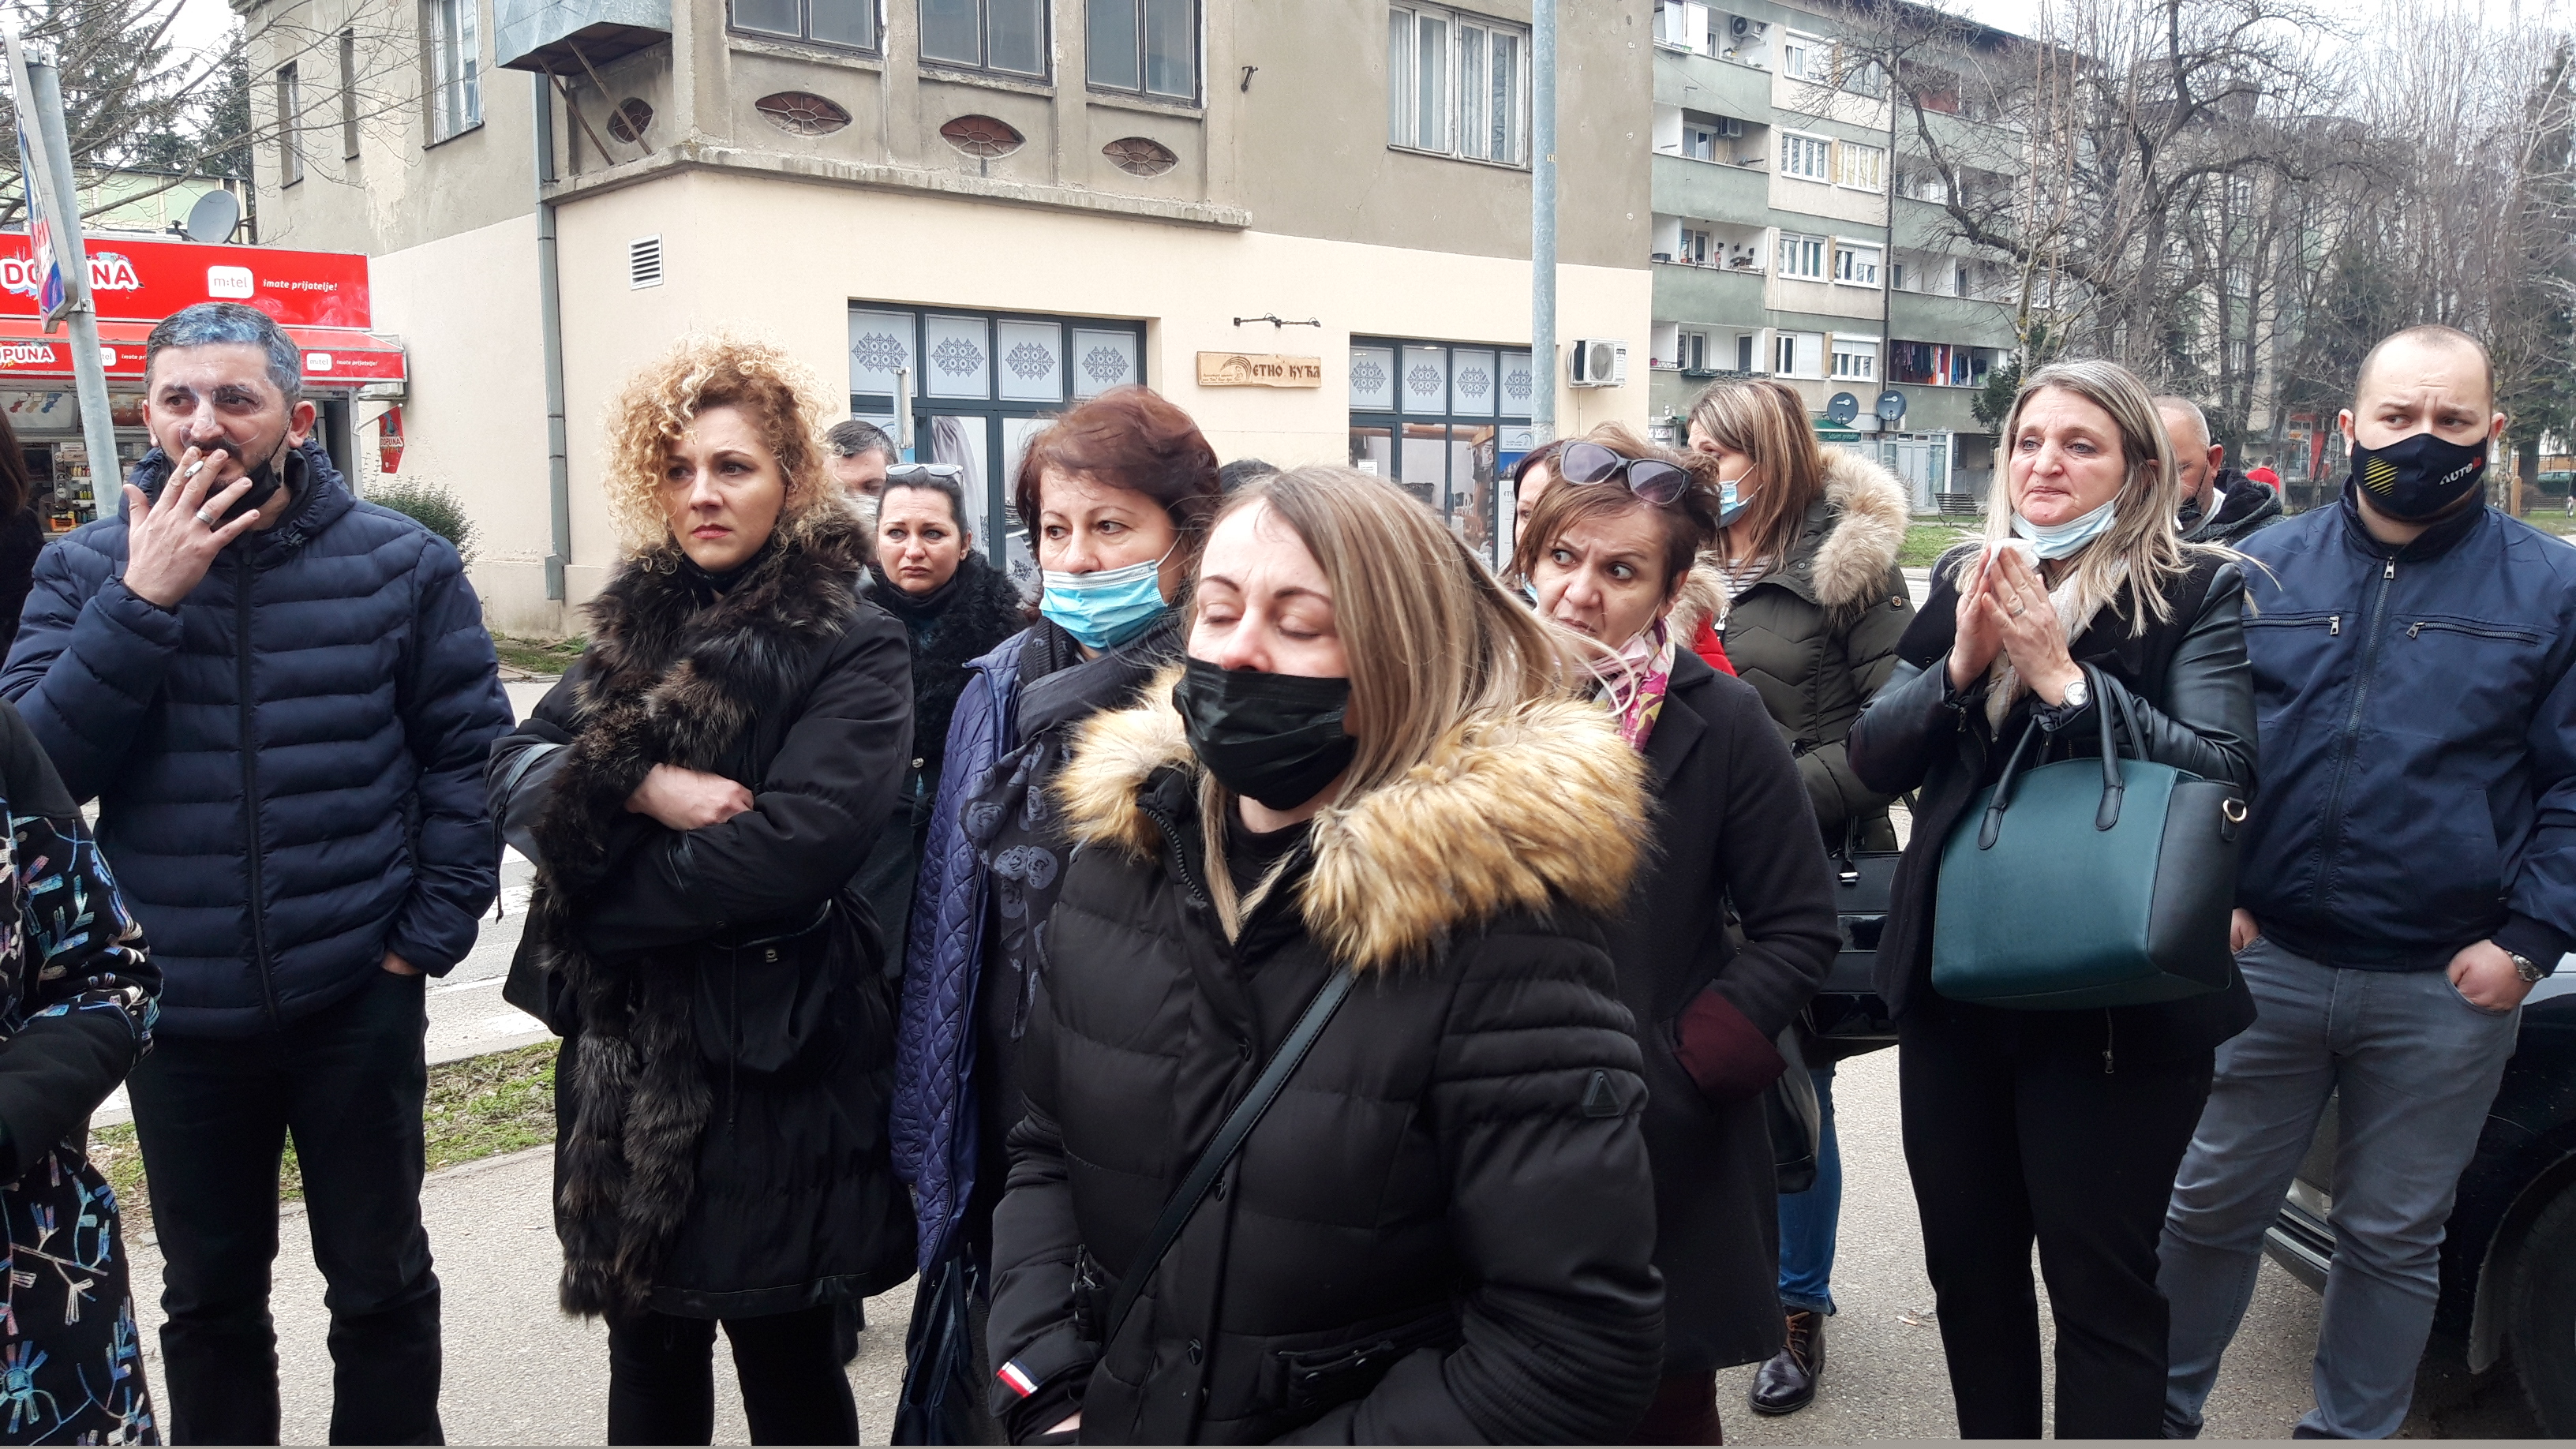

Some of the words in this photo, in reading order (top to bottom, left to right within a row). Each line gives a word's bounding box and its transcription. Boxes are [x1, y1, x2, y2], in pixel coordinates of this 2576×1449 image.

[214, 277, 248, 288] m:tel
[263, 279, 289, 288] imate
[291, 282, 338, 292] prijatelje!
[0, 348, 52, 360] PUNA
